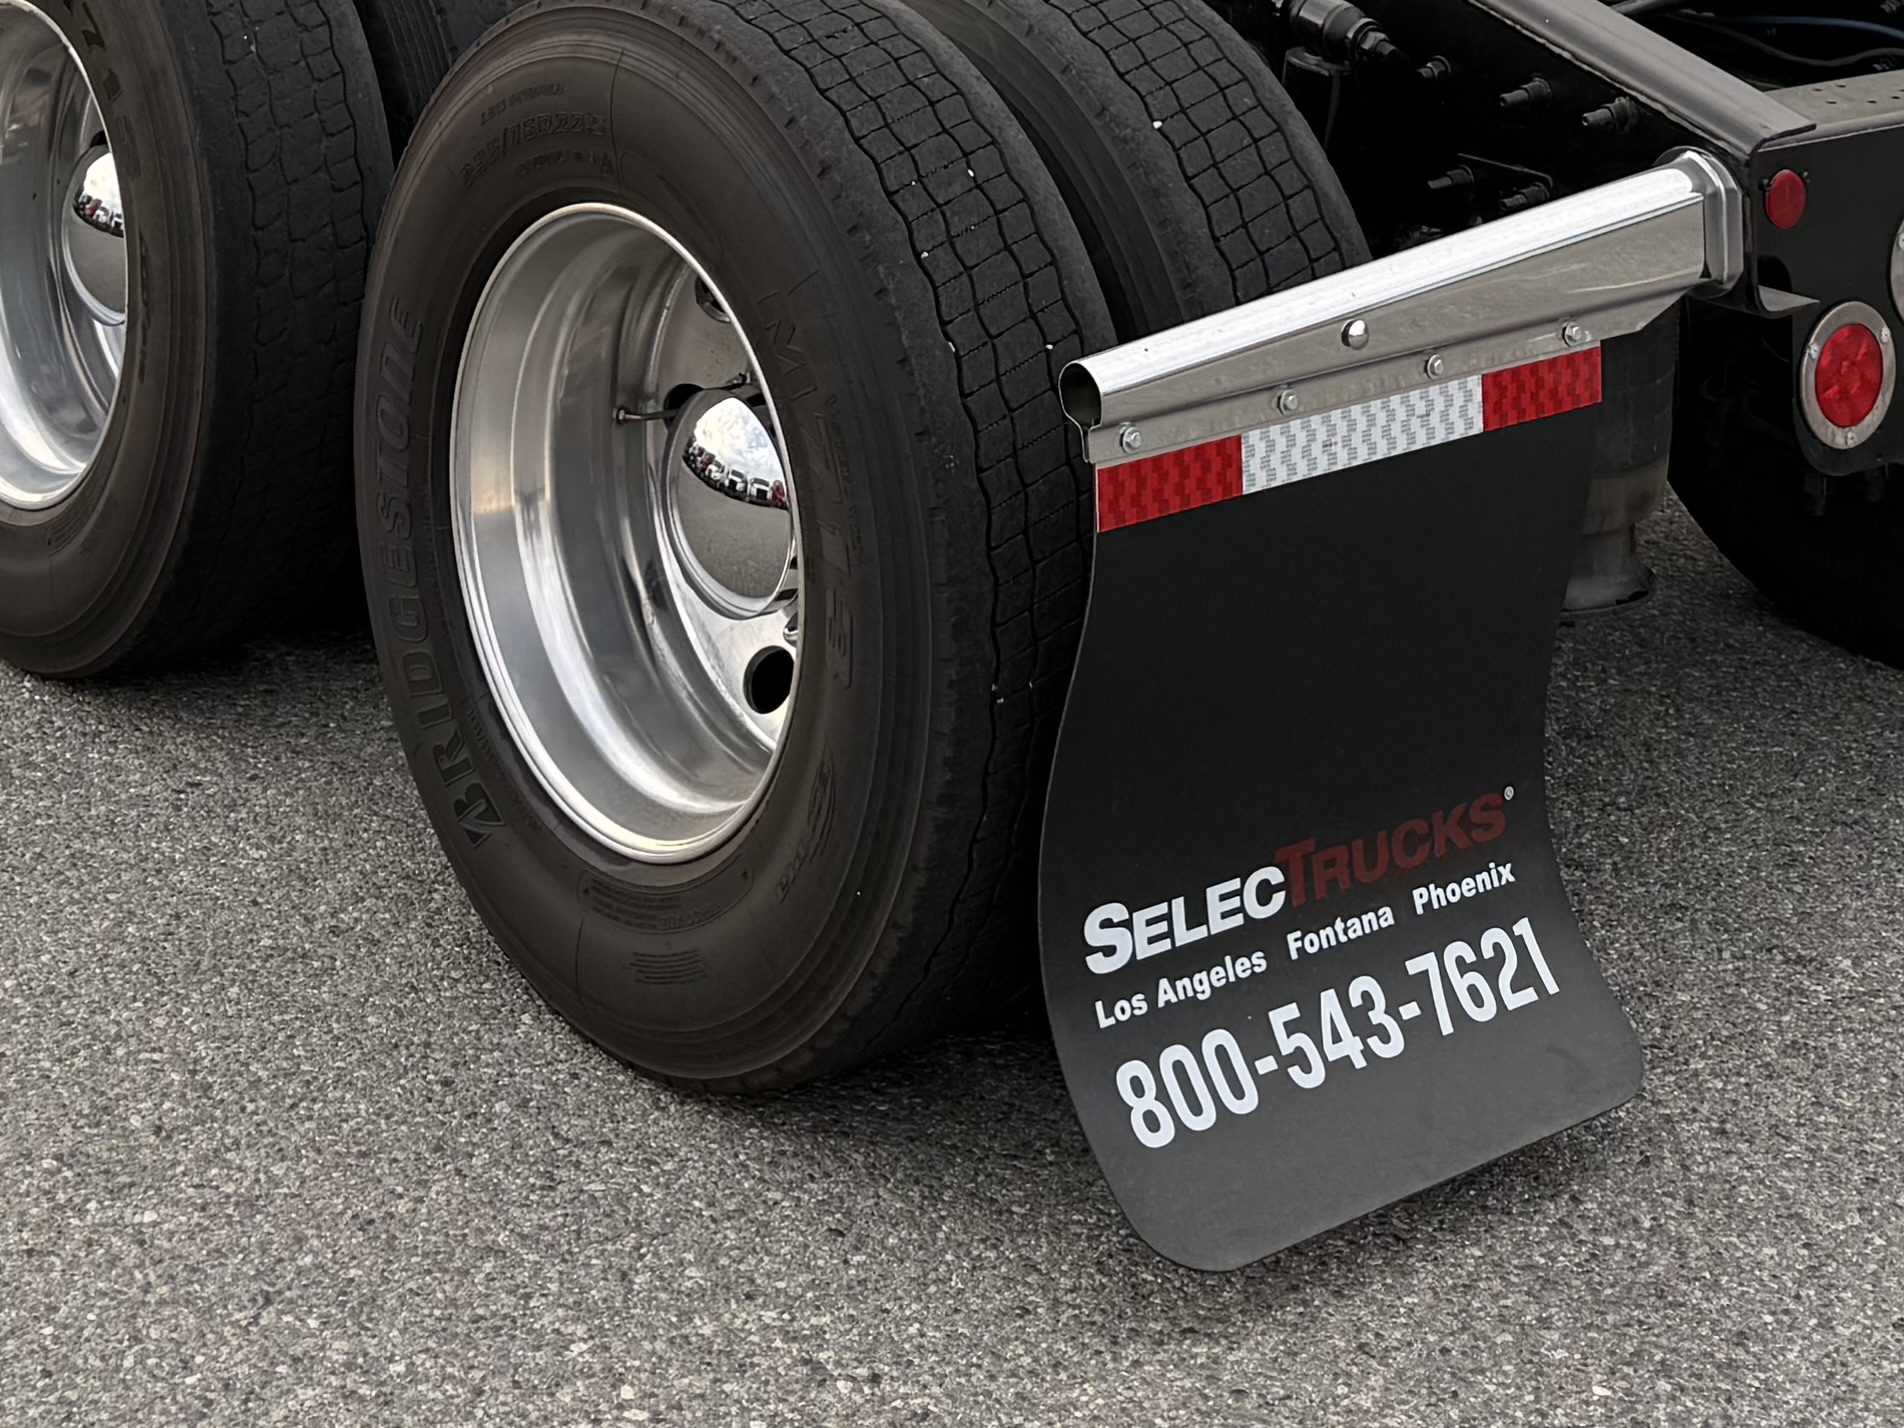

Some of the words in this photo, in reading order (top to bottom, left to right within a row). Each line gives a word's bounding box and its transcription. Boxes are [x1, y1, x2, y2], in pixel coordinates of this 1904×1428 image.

[373, 295, 505, 852] BRIDGESTONE
[1083, 794, 1507, 975] SELECTRUCKS
[1096, 994, 1148, 1029] Los
[1157, 951, 1267, 1008] Angeles
[1286, 906, 1395, 960] Fontana
[1412, 862, 1516, 915] Phoenix
[1115, 917, 1560, 1149] 800-543-7621
